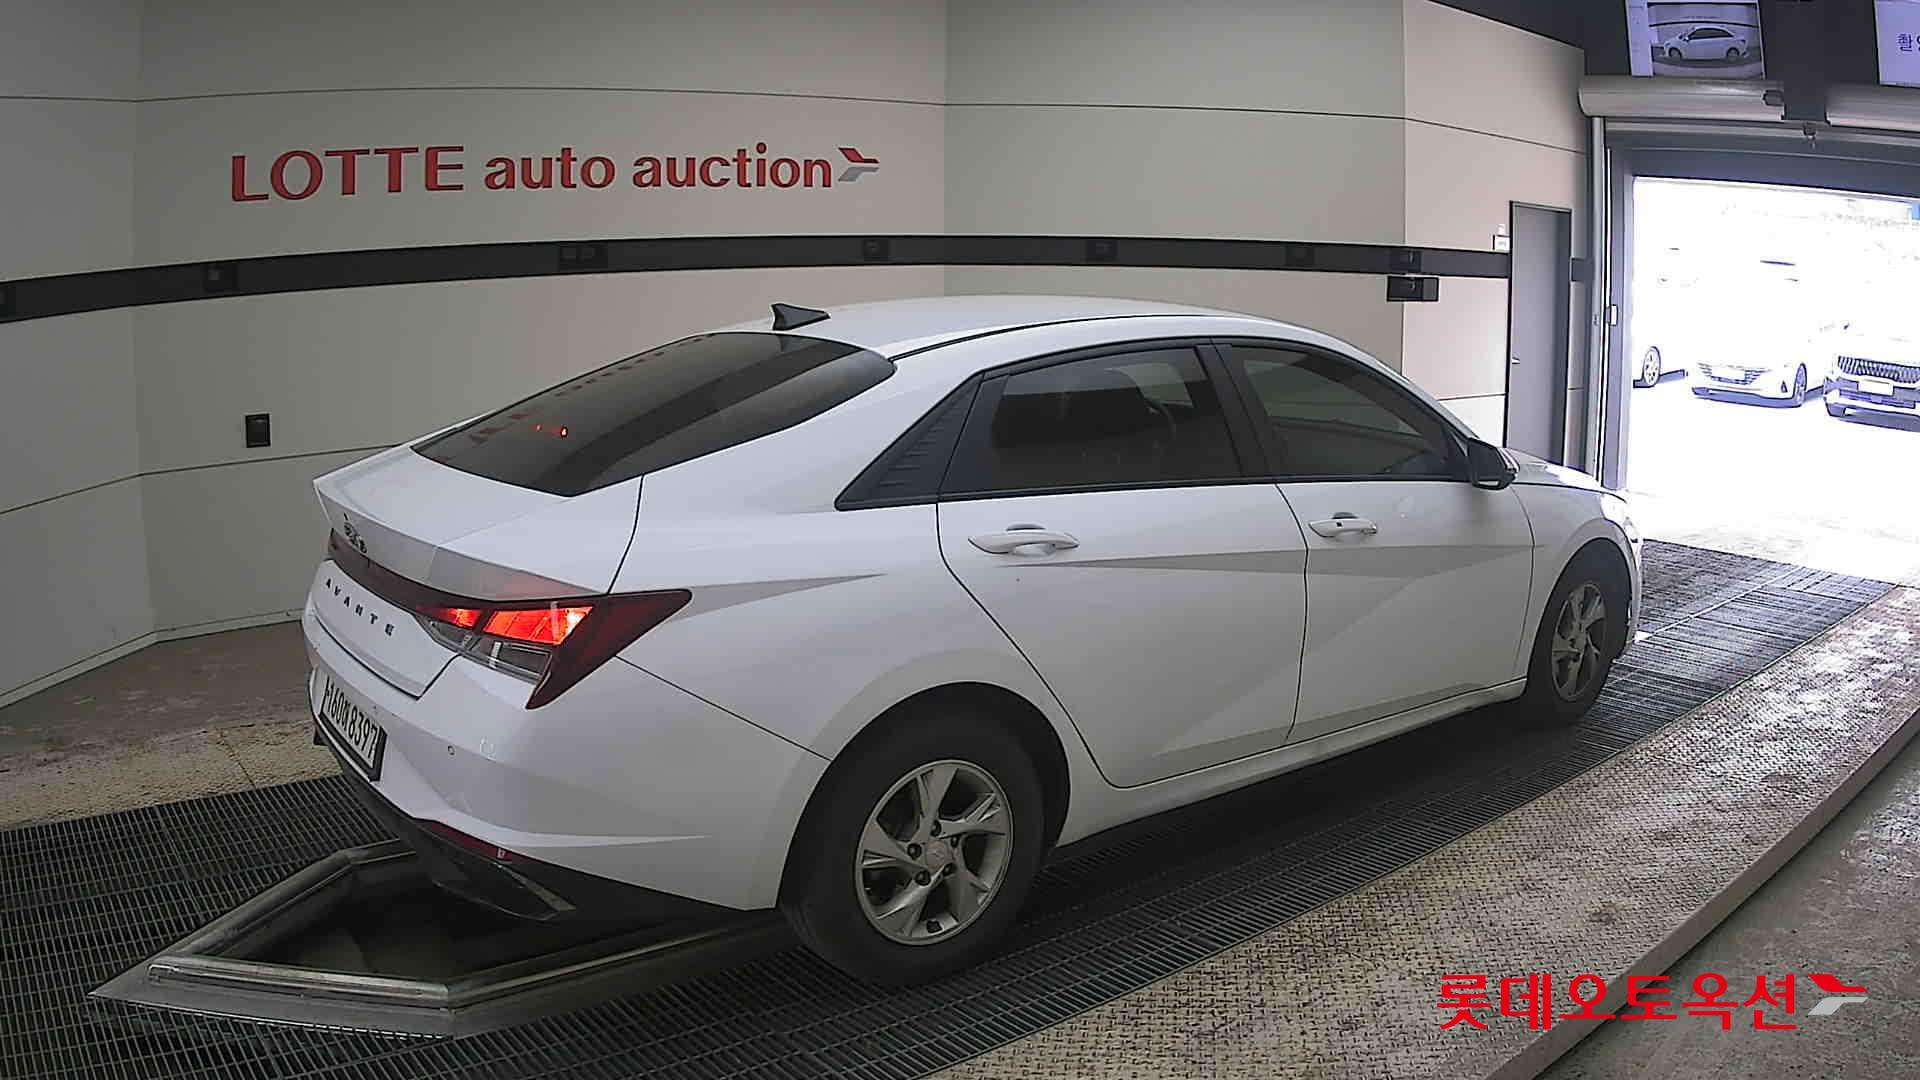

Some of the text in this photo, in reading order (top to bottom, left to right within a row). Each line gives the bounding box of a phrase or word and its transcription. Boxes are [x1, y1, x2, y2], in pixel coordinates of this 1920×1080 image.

[231, 142, 832, 202] LOTTE auto auction
[326, 578, 394, 636] AVANTE
